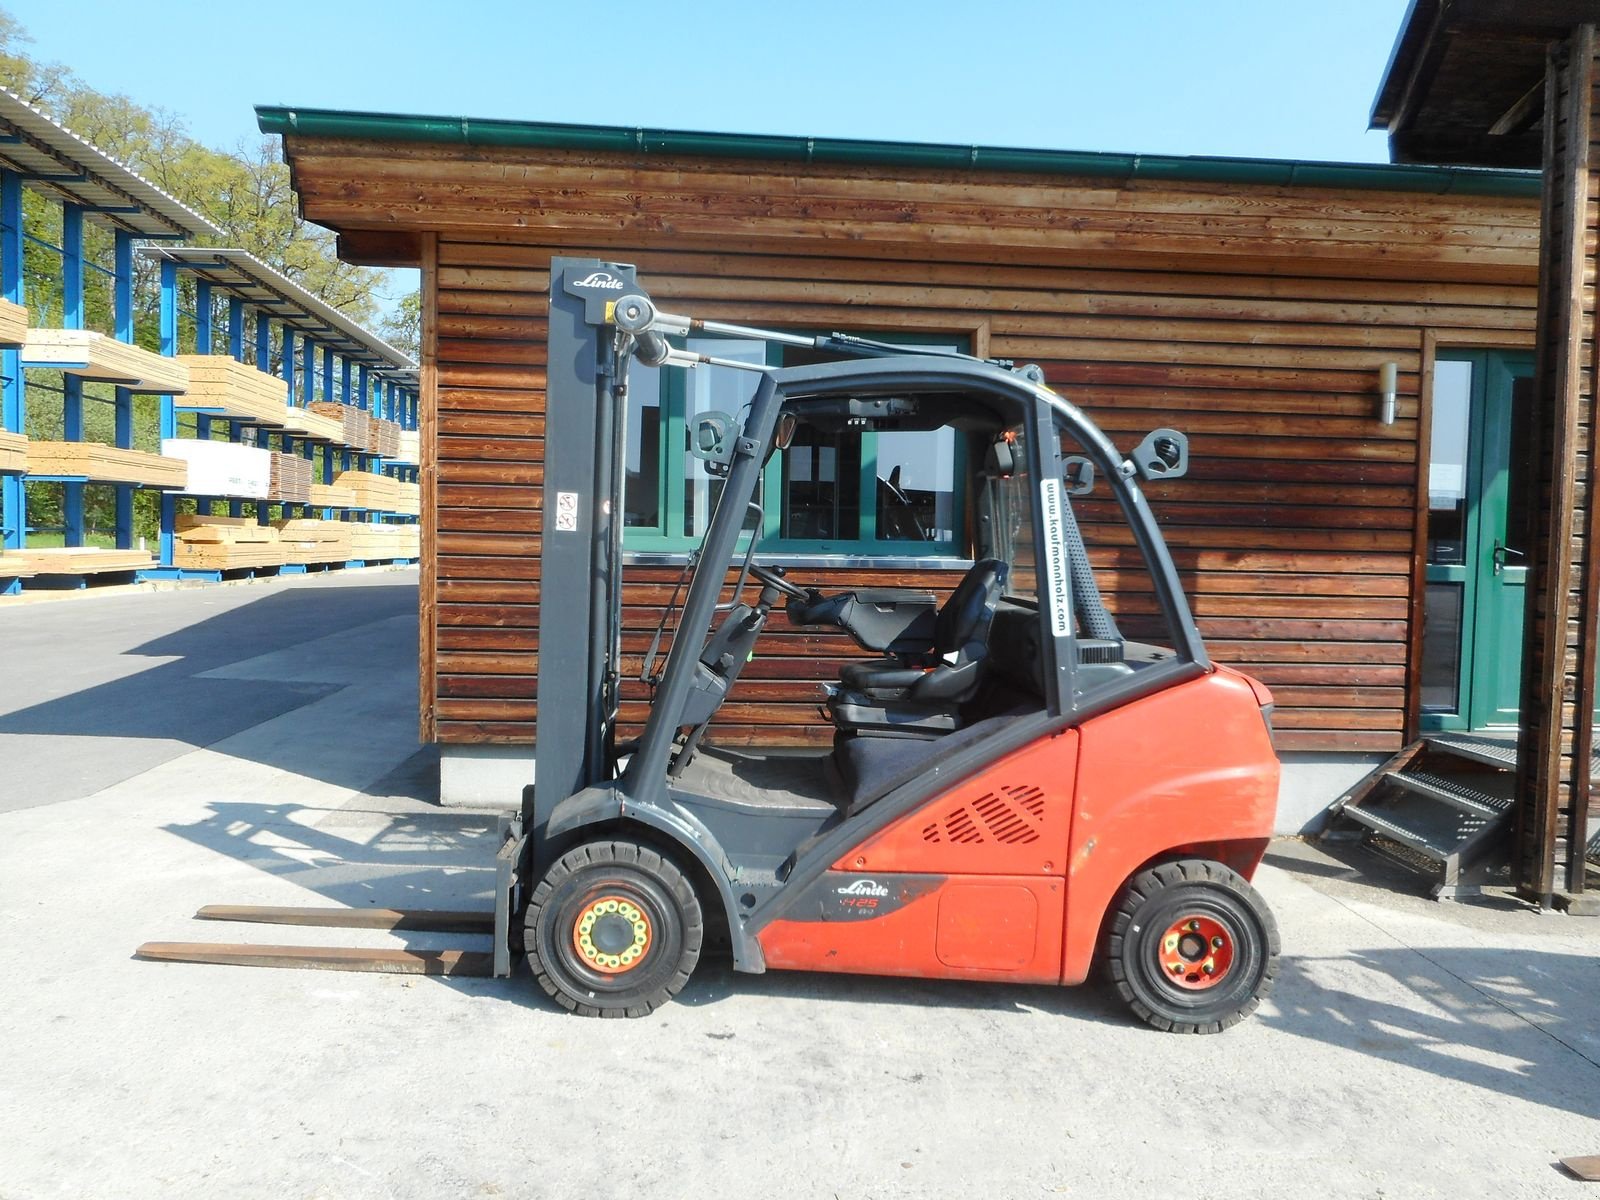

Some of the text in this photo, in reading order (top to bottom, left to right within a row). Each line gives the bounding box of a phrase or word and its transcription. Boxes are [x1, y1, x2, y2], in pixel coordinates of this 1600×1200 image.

[573, 272, 624, 290] Linde
[1047, 483, 1066, 631] www.kaufmannholz.com
[837, 879, 888, 897] Linde
